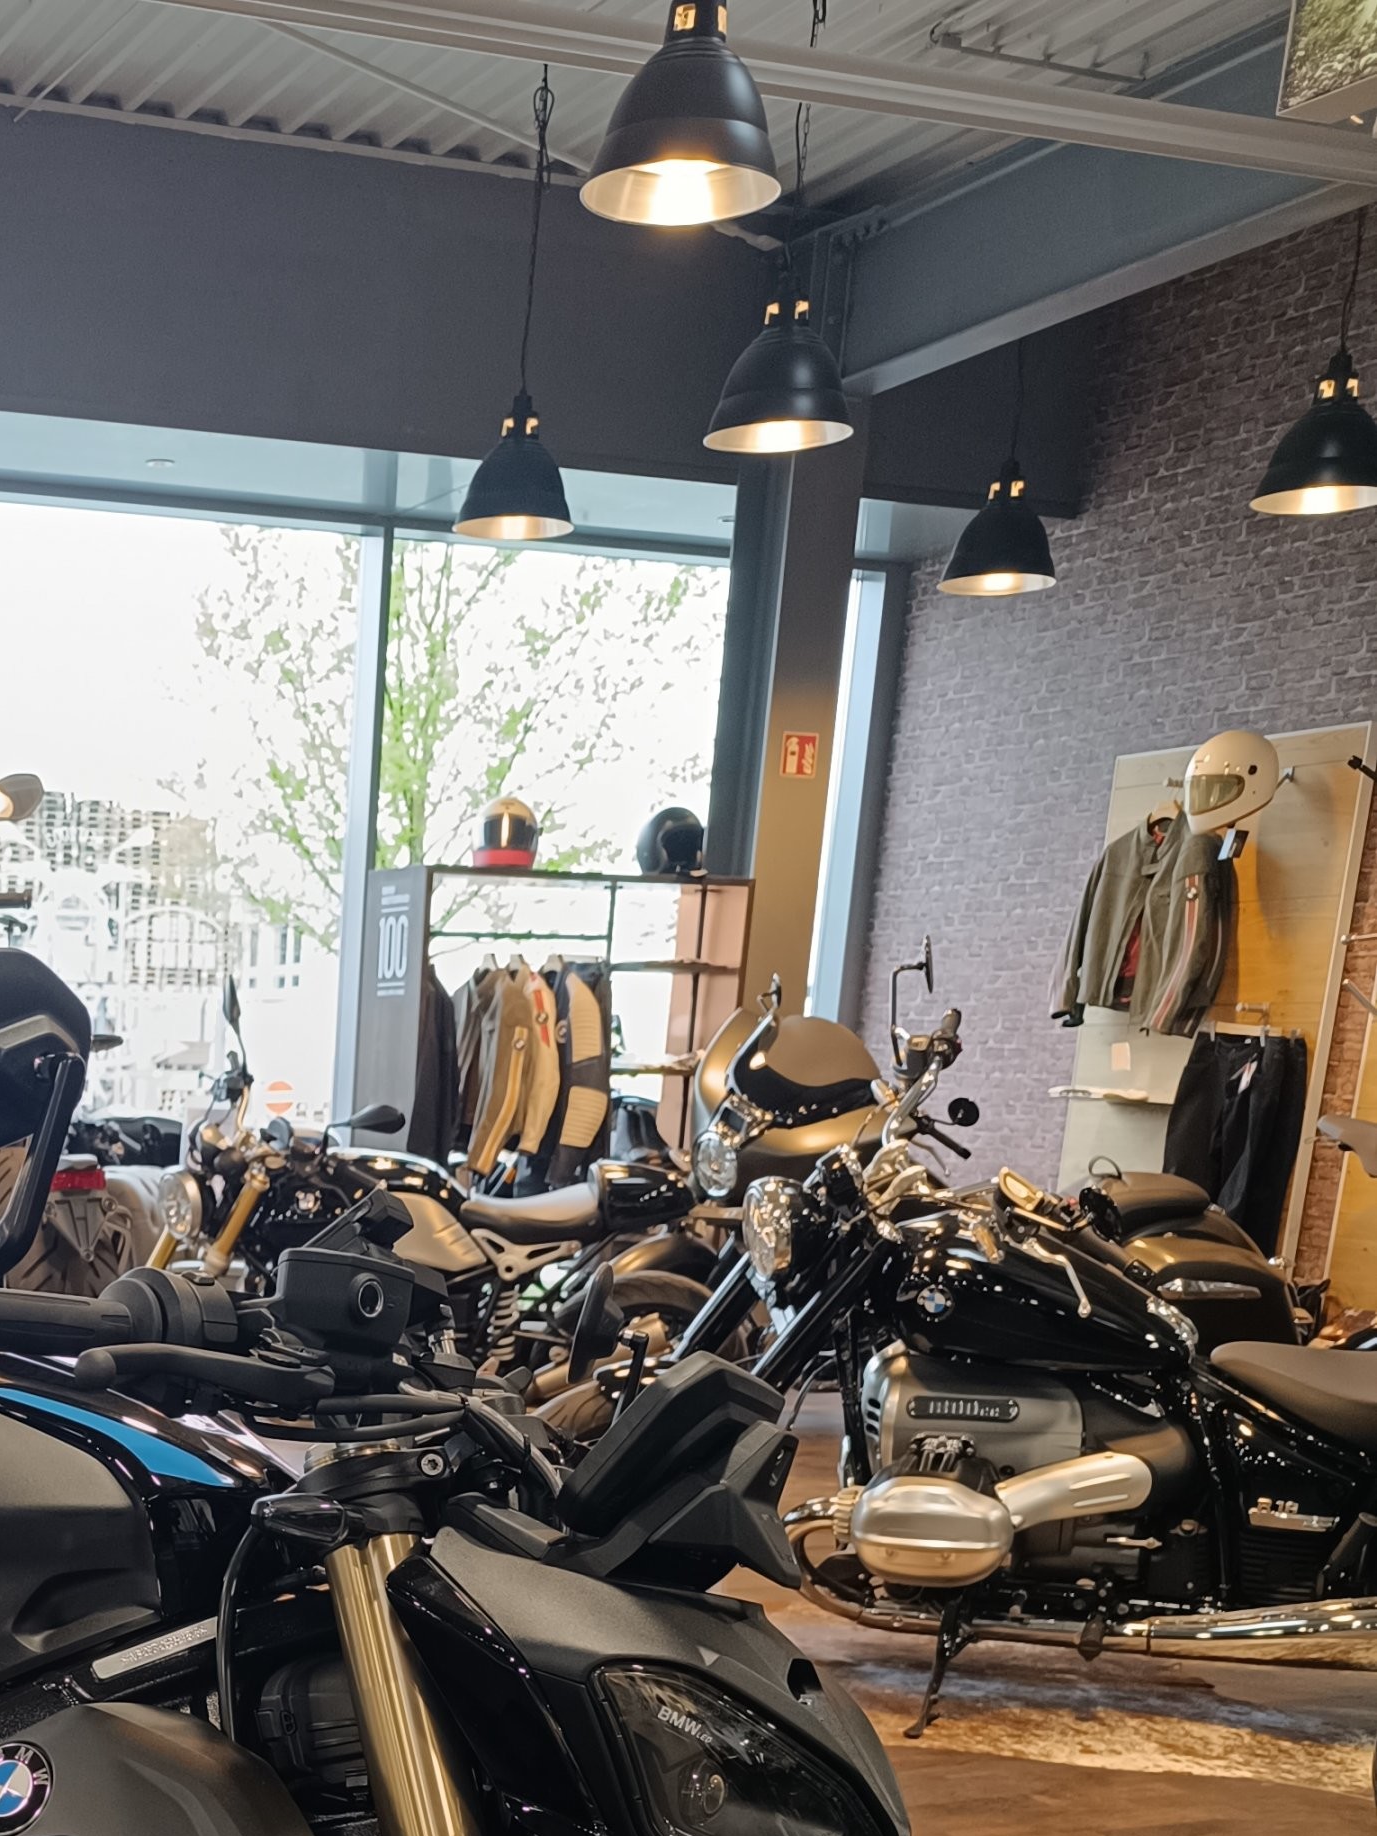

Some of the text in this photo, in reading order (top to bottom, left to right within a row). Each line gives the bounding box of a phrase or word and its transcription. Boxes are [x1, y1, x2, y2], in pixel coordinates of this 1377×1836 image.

[378, 914, 409, 979] 100
[658, 1706, 714, 1743] BMW LED
